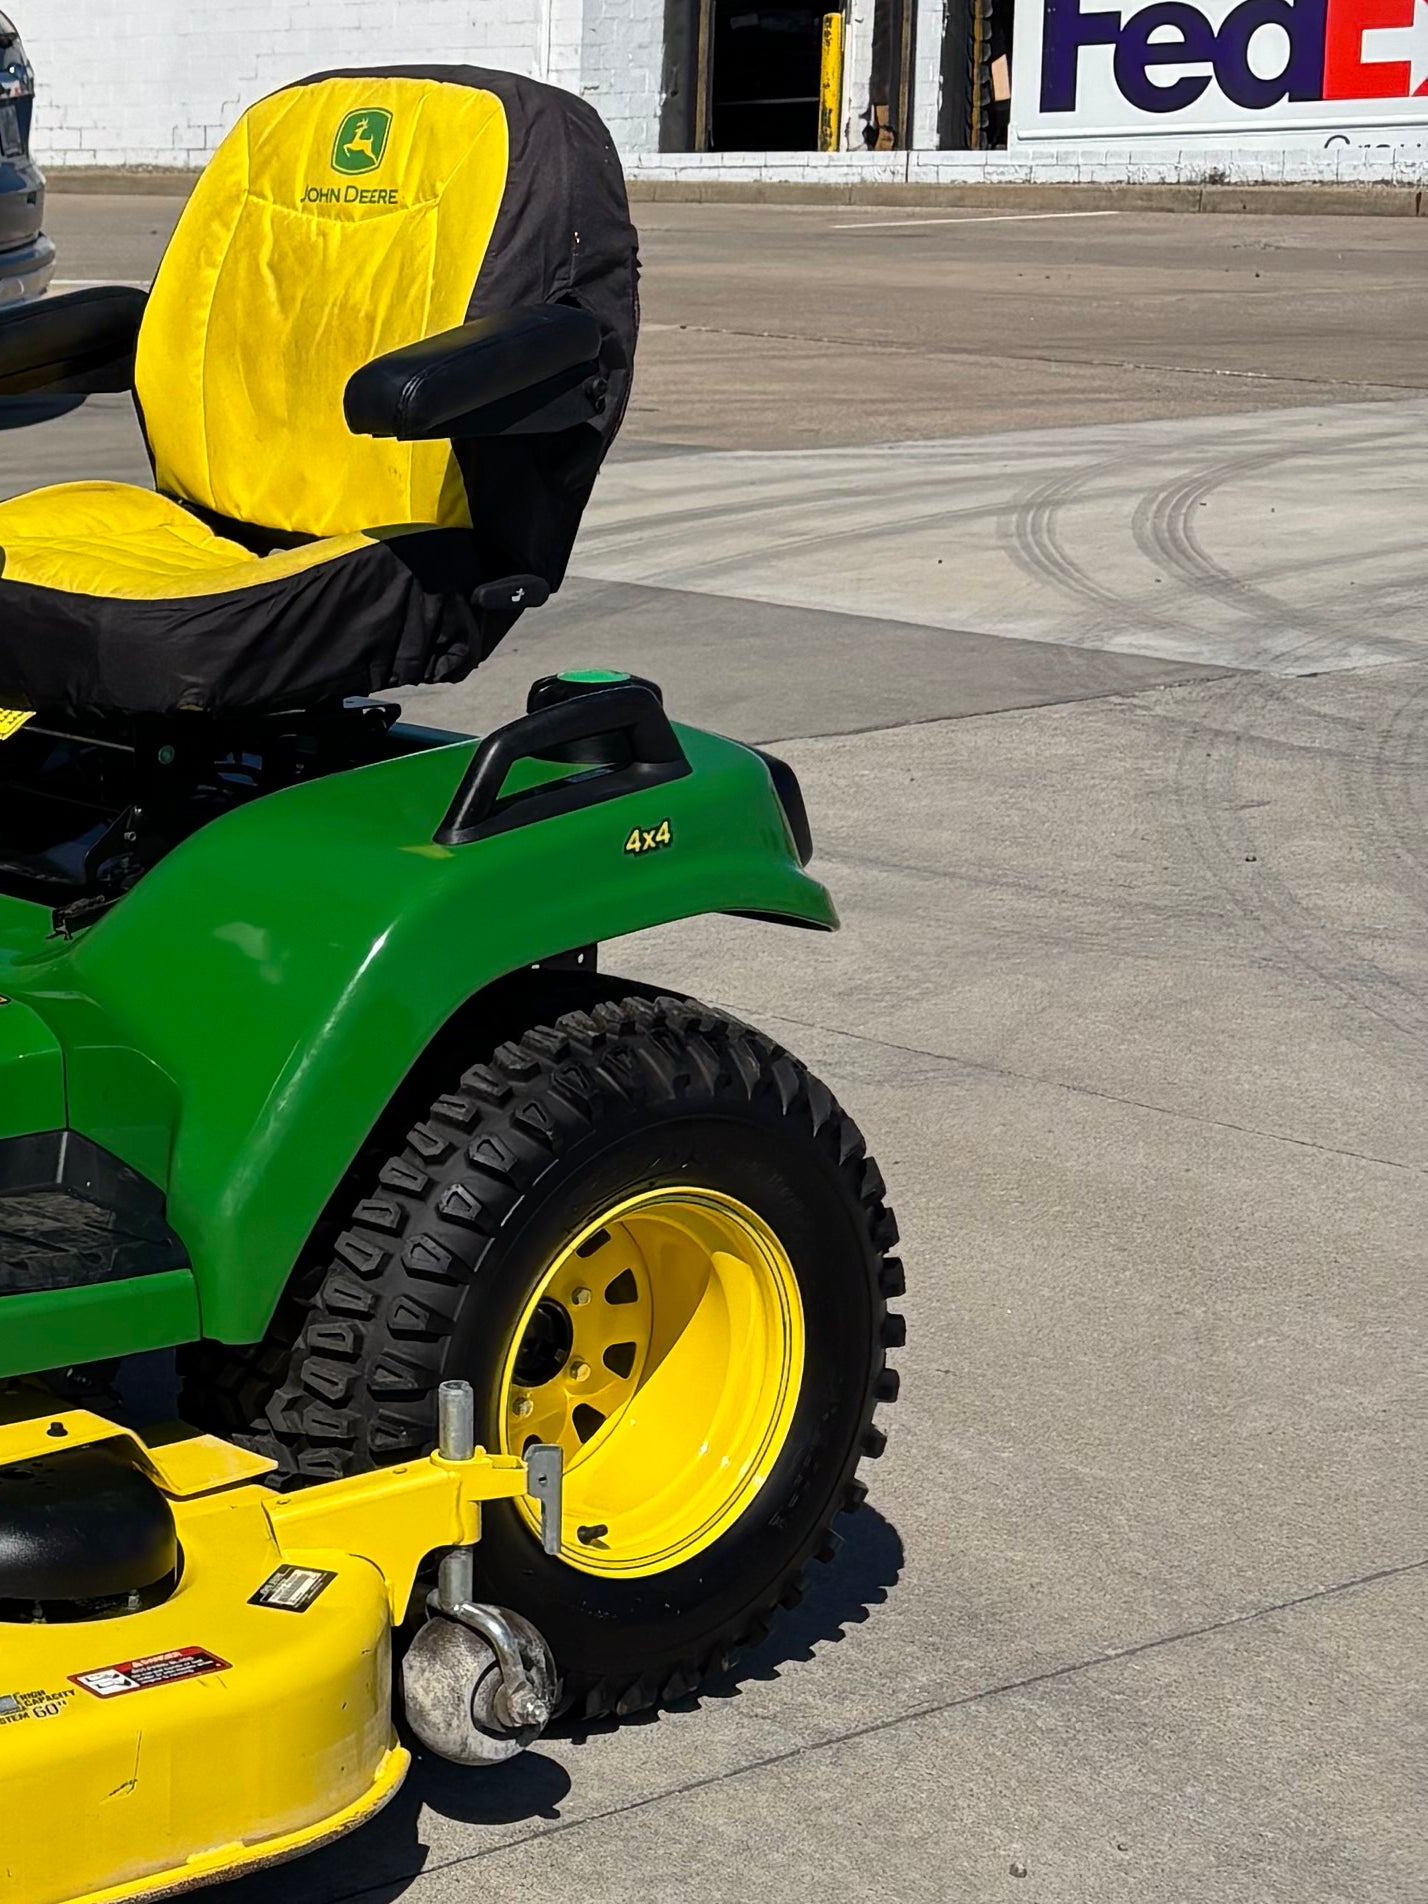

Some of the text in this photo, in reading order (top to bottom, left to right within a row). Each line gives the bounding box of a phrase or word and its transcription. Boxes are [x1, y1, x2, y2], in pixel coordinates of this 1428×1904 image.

[300, 184, 398, 205] JOHN DEERE
[32, 1699, 68, 1718] 60"
